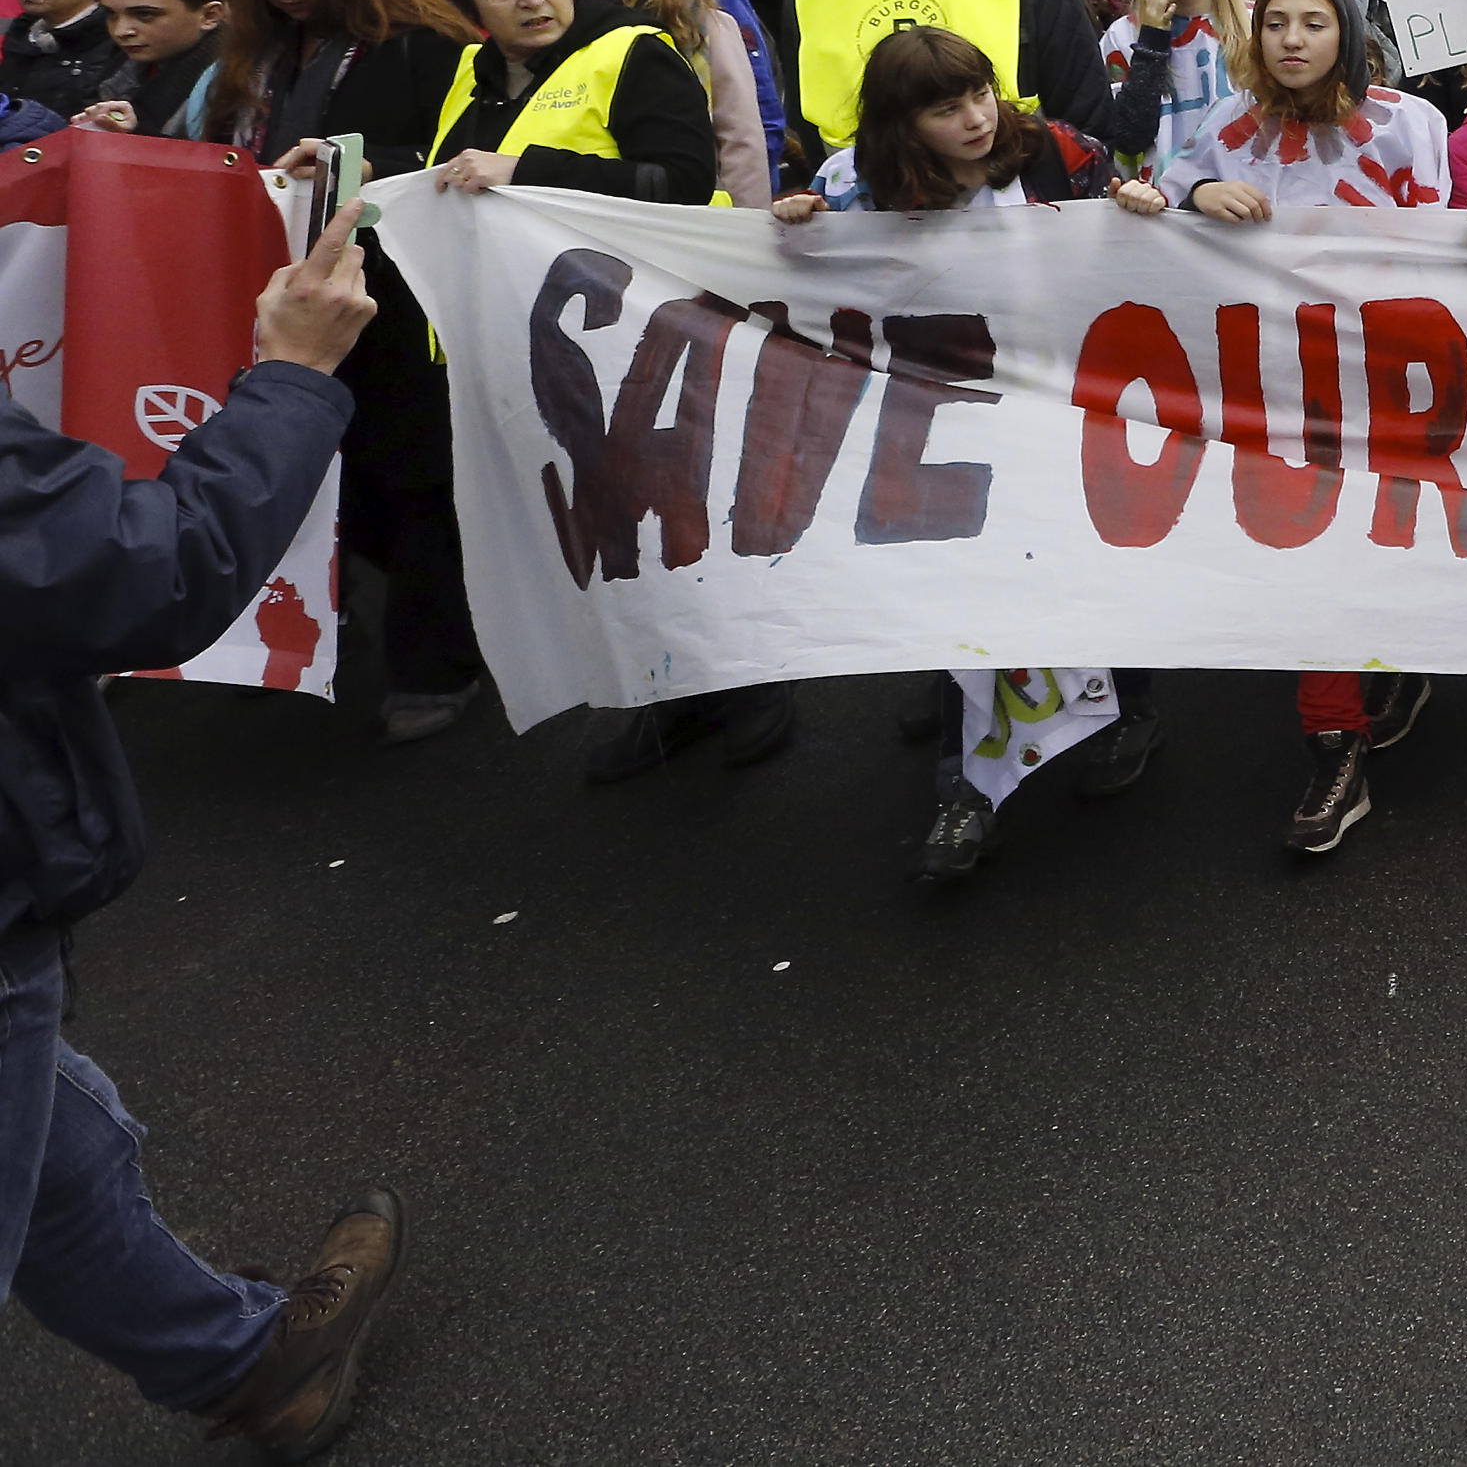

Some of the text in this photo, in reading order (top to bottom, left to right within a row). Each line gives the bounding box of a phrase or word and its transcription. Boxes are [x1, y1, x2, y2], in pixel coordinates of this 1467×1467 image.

[868, 0, 938, 27] BURGER
[536, 87, 572, 101] Uccle
[533, 102, 547, 111] En
[530, 247, 1003, 590] SAVE
